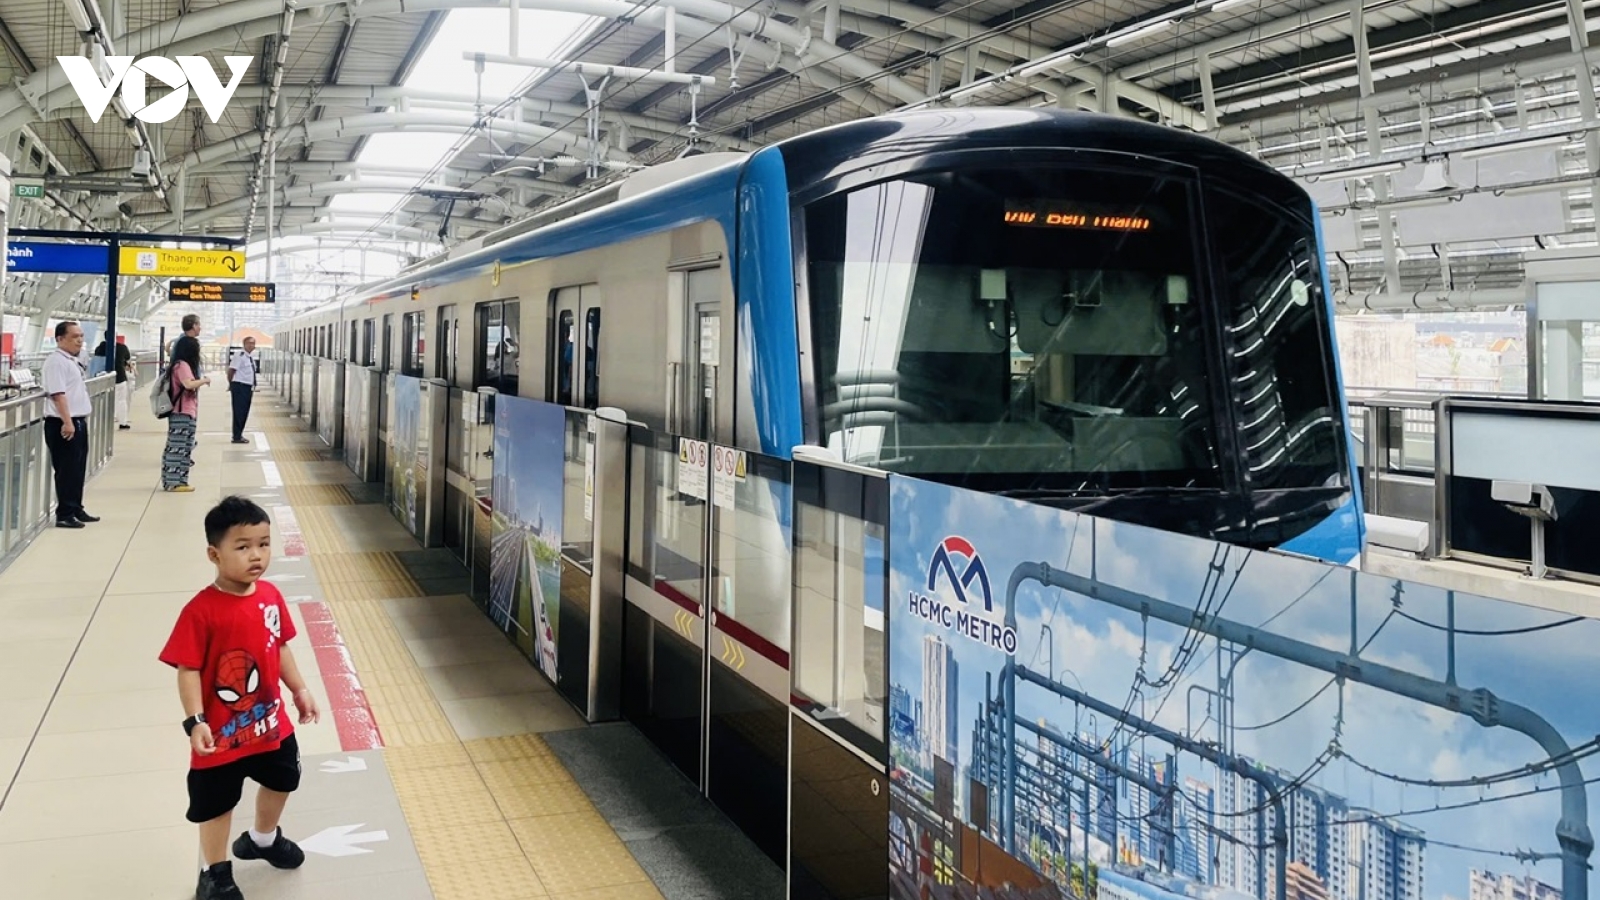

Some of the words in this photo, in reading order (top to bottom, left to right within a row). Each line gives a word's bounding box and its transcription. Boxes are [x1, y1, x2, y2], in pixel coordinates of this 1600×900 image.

[19, 185, 39, 196] EXIT
[161, 252, 193, 264] Thang
[160, 264, 189, 272] Elevator
[908, 591, 952, 628] HCMC
[956, 609, 1017, 654] METRO
